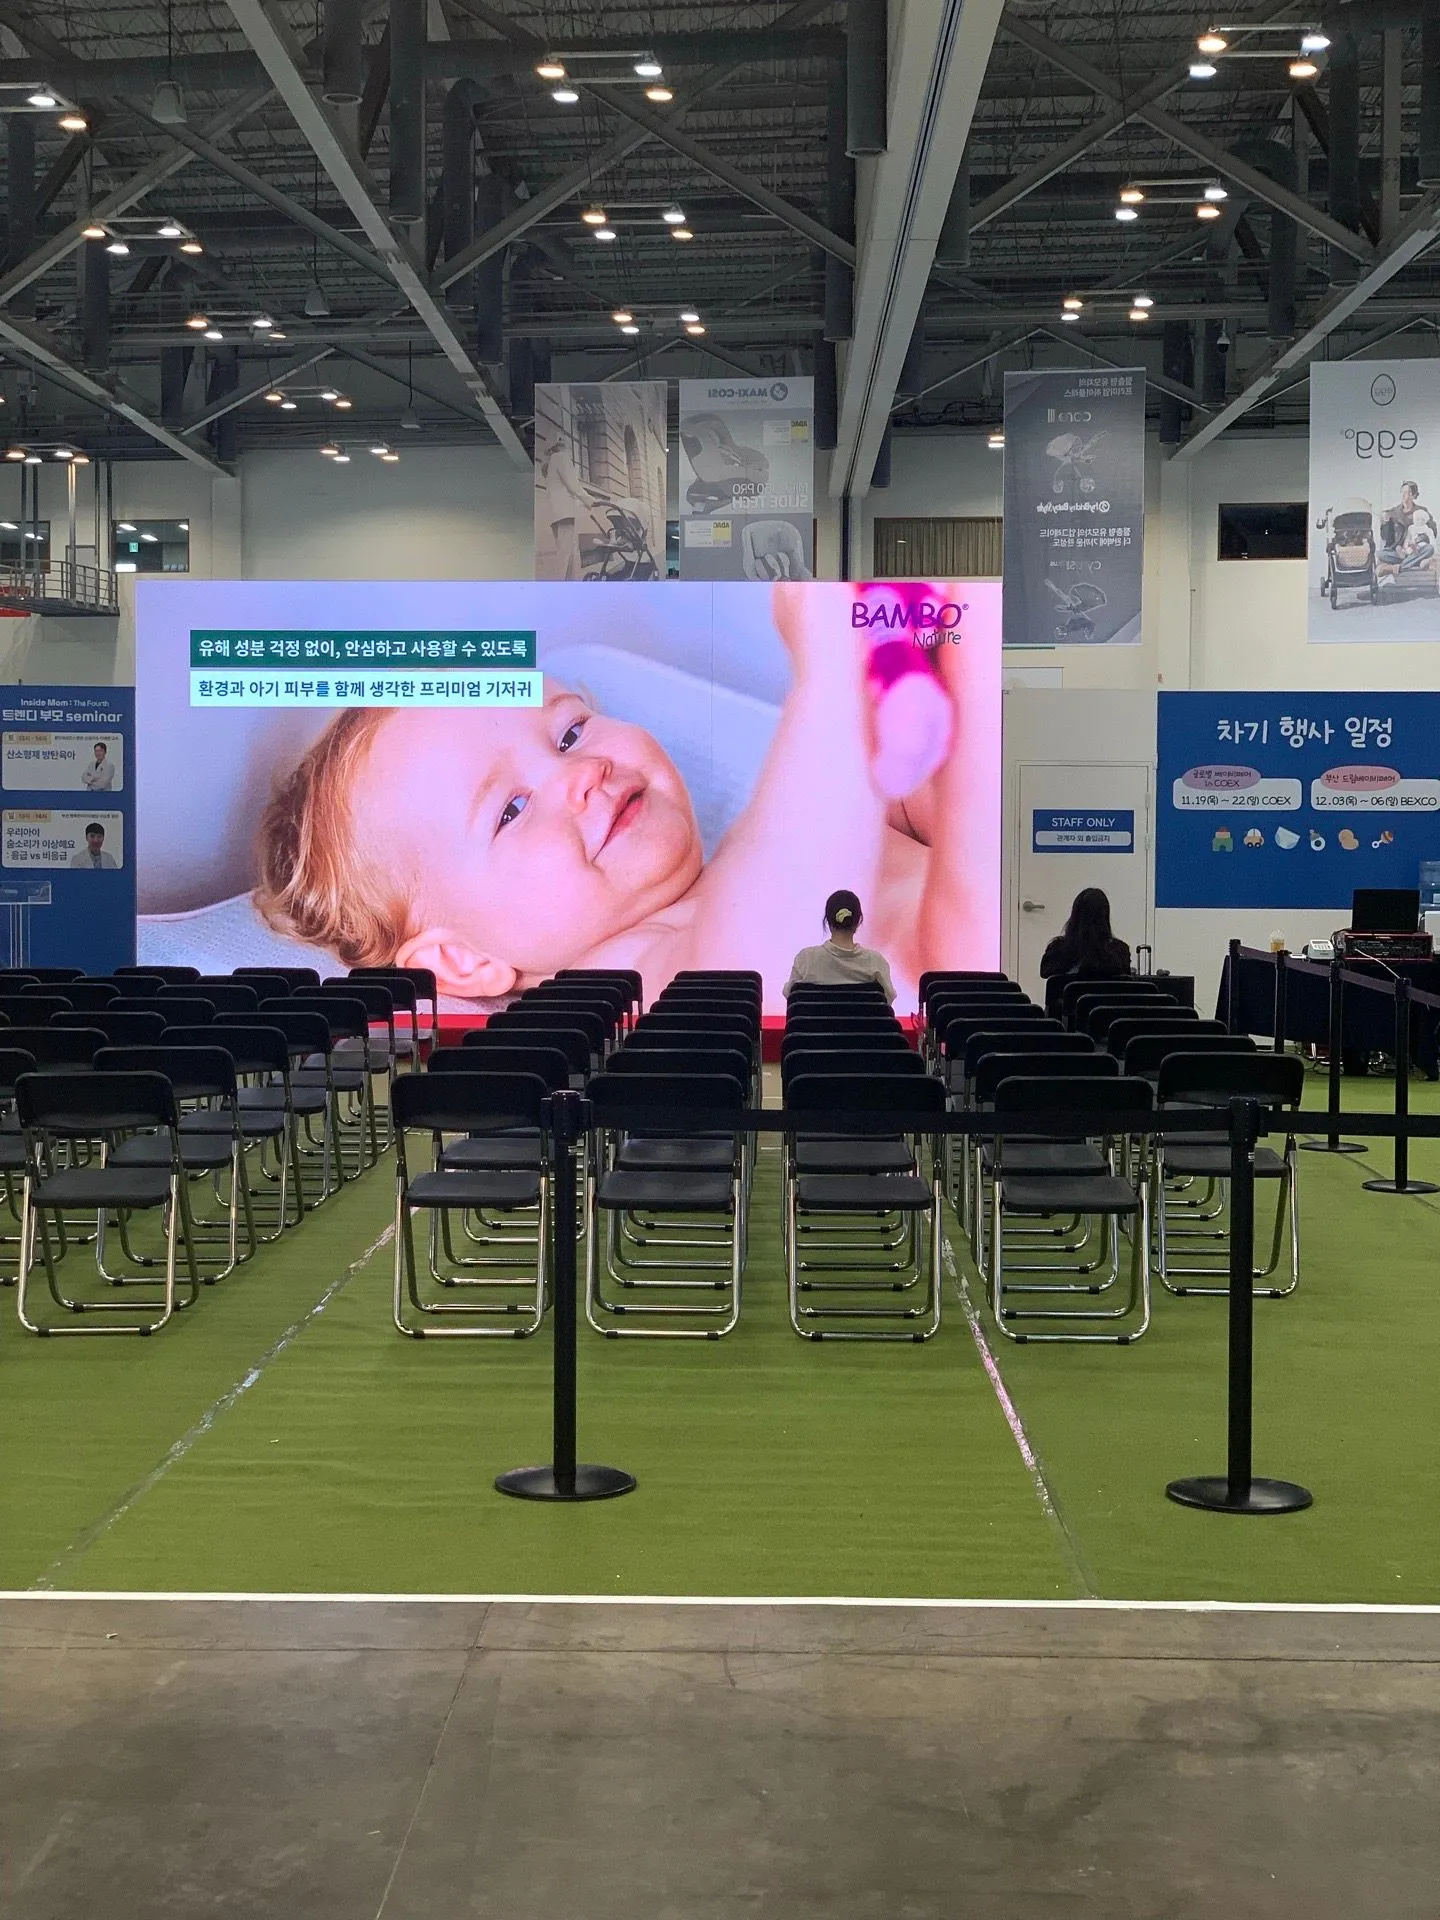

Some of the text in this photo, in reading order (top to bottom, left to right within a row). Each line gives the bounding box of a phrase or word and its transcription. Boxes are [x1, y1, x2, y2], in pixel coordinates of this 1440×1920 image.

[912, 629, 962, 649] Nature
[199, 639, 527, 659] 유해 성분 걱정 없이, 안심하고 사용할 수 있도록
[199, 680, 532, 698] 환경과 아기 피부를 함께 생각한 프리미엄 기저귀
[20, 698, 46, 707] Inside
[47, 698, 68, 707] Mom
[74, 699, 87, 707] The
[87, 699, 110, 707] Fourth
[2, 709, 123, 723] 트렌디 부모 seminar
[1217, 716, 1393, 749] 차기 행사 일정
[1214, 779, 1240, 788] COEX
[1325, 774, 1339, 784] 부산
[1261, 795, 1292, 806] COEX
[1400, 796, 1438, 806] BEXCO
[1051, 817, 1116, 827] STAFF ONLY
[6, 827, 40, 837] 우리아이
[1056, 834, 1111, 843] 관계자 외 출입금지
[6, 839, 76, 849] 숨소리가 이상해요
[10, 850, 28, 861] 응급
[30, 852, 41, 860] vs
[42, 850, 68, 861] 비응급
